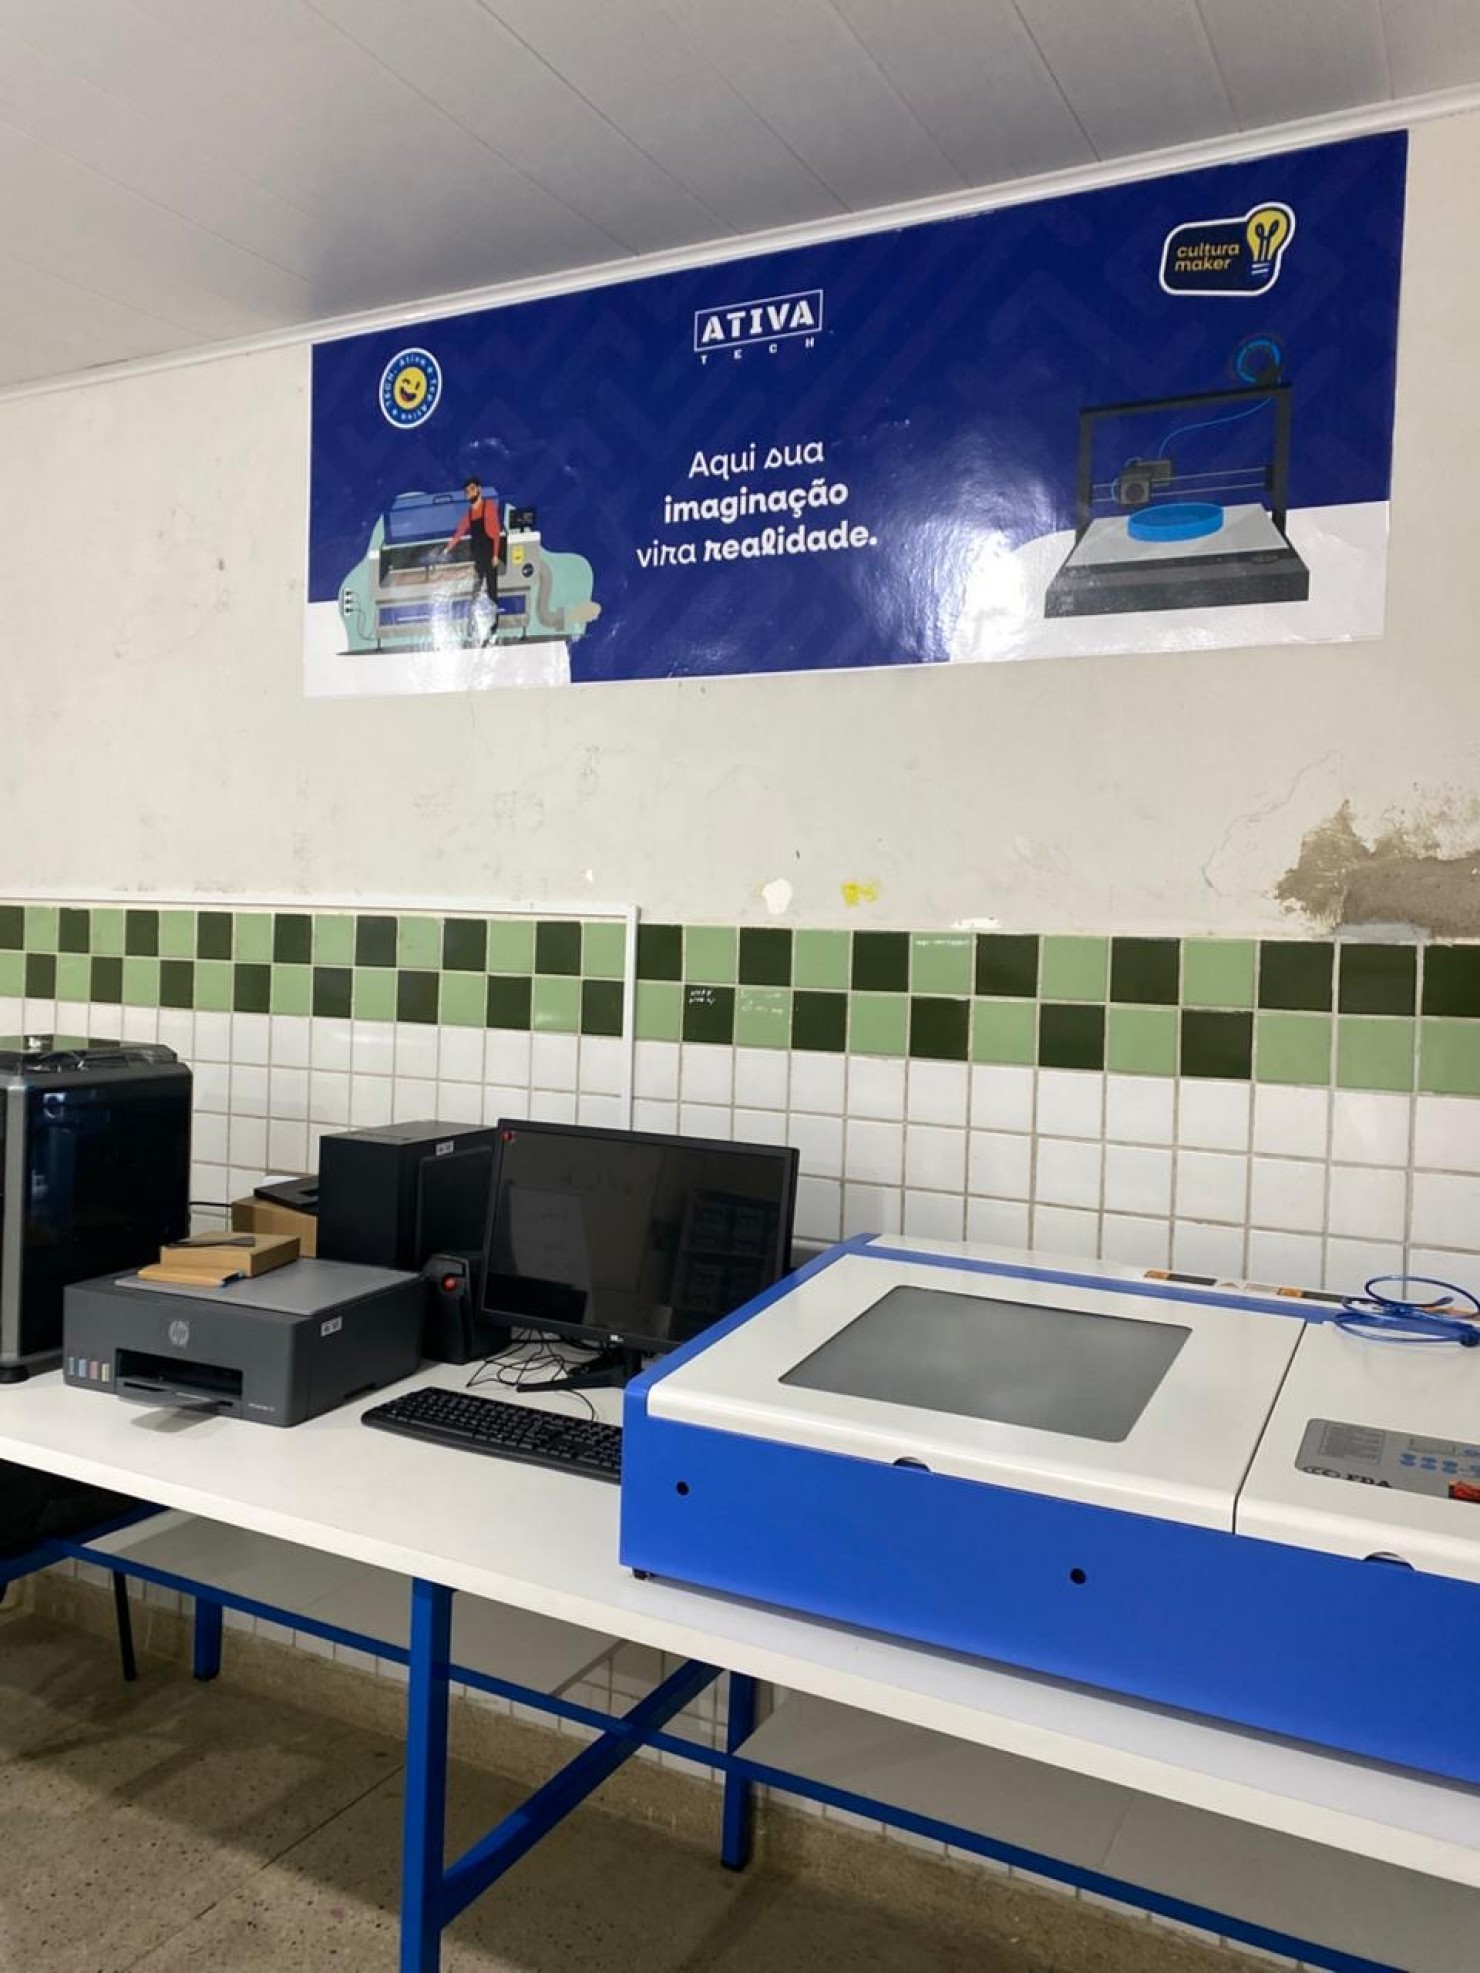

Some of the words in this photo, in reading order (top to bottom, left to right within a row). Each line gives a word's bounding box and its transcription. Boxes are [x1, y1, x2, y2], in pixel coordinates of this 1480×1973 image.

[1174, 256, 1232, 272] maker
[1176, 241, 1240, 258] cultura
[701, 299, 815, 343] ATIVA
[700, 337, 815, 365] TECH
[688, 443, 756, 481] Aqui
[763, 440, 825, 469] sua
[664, 477, 849, 524] imaginação
[636, 539, 696, 569] vira
[703, 520, 878, 563] realidade.
